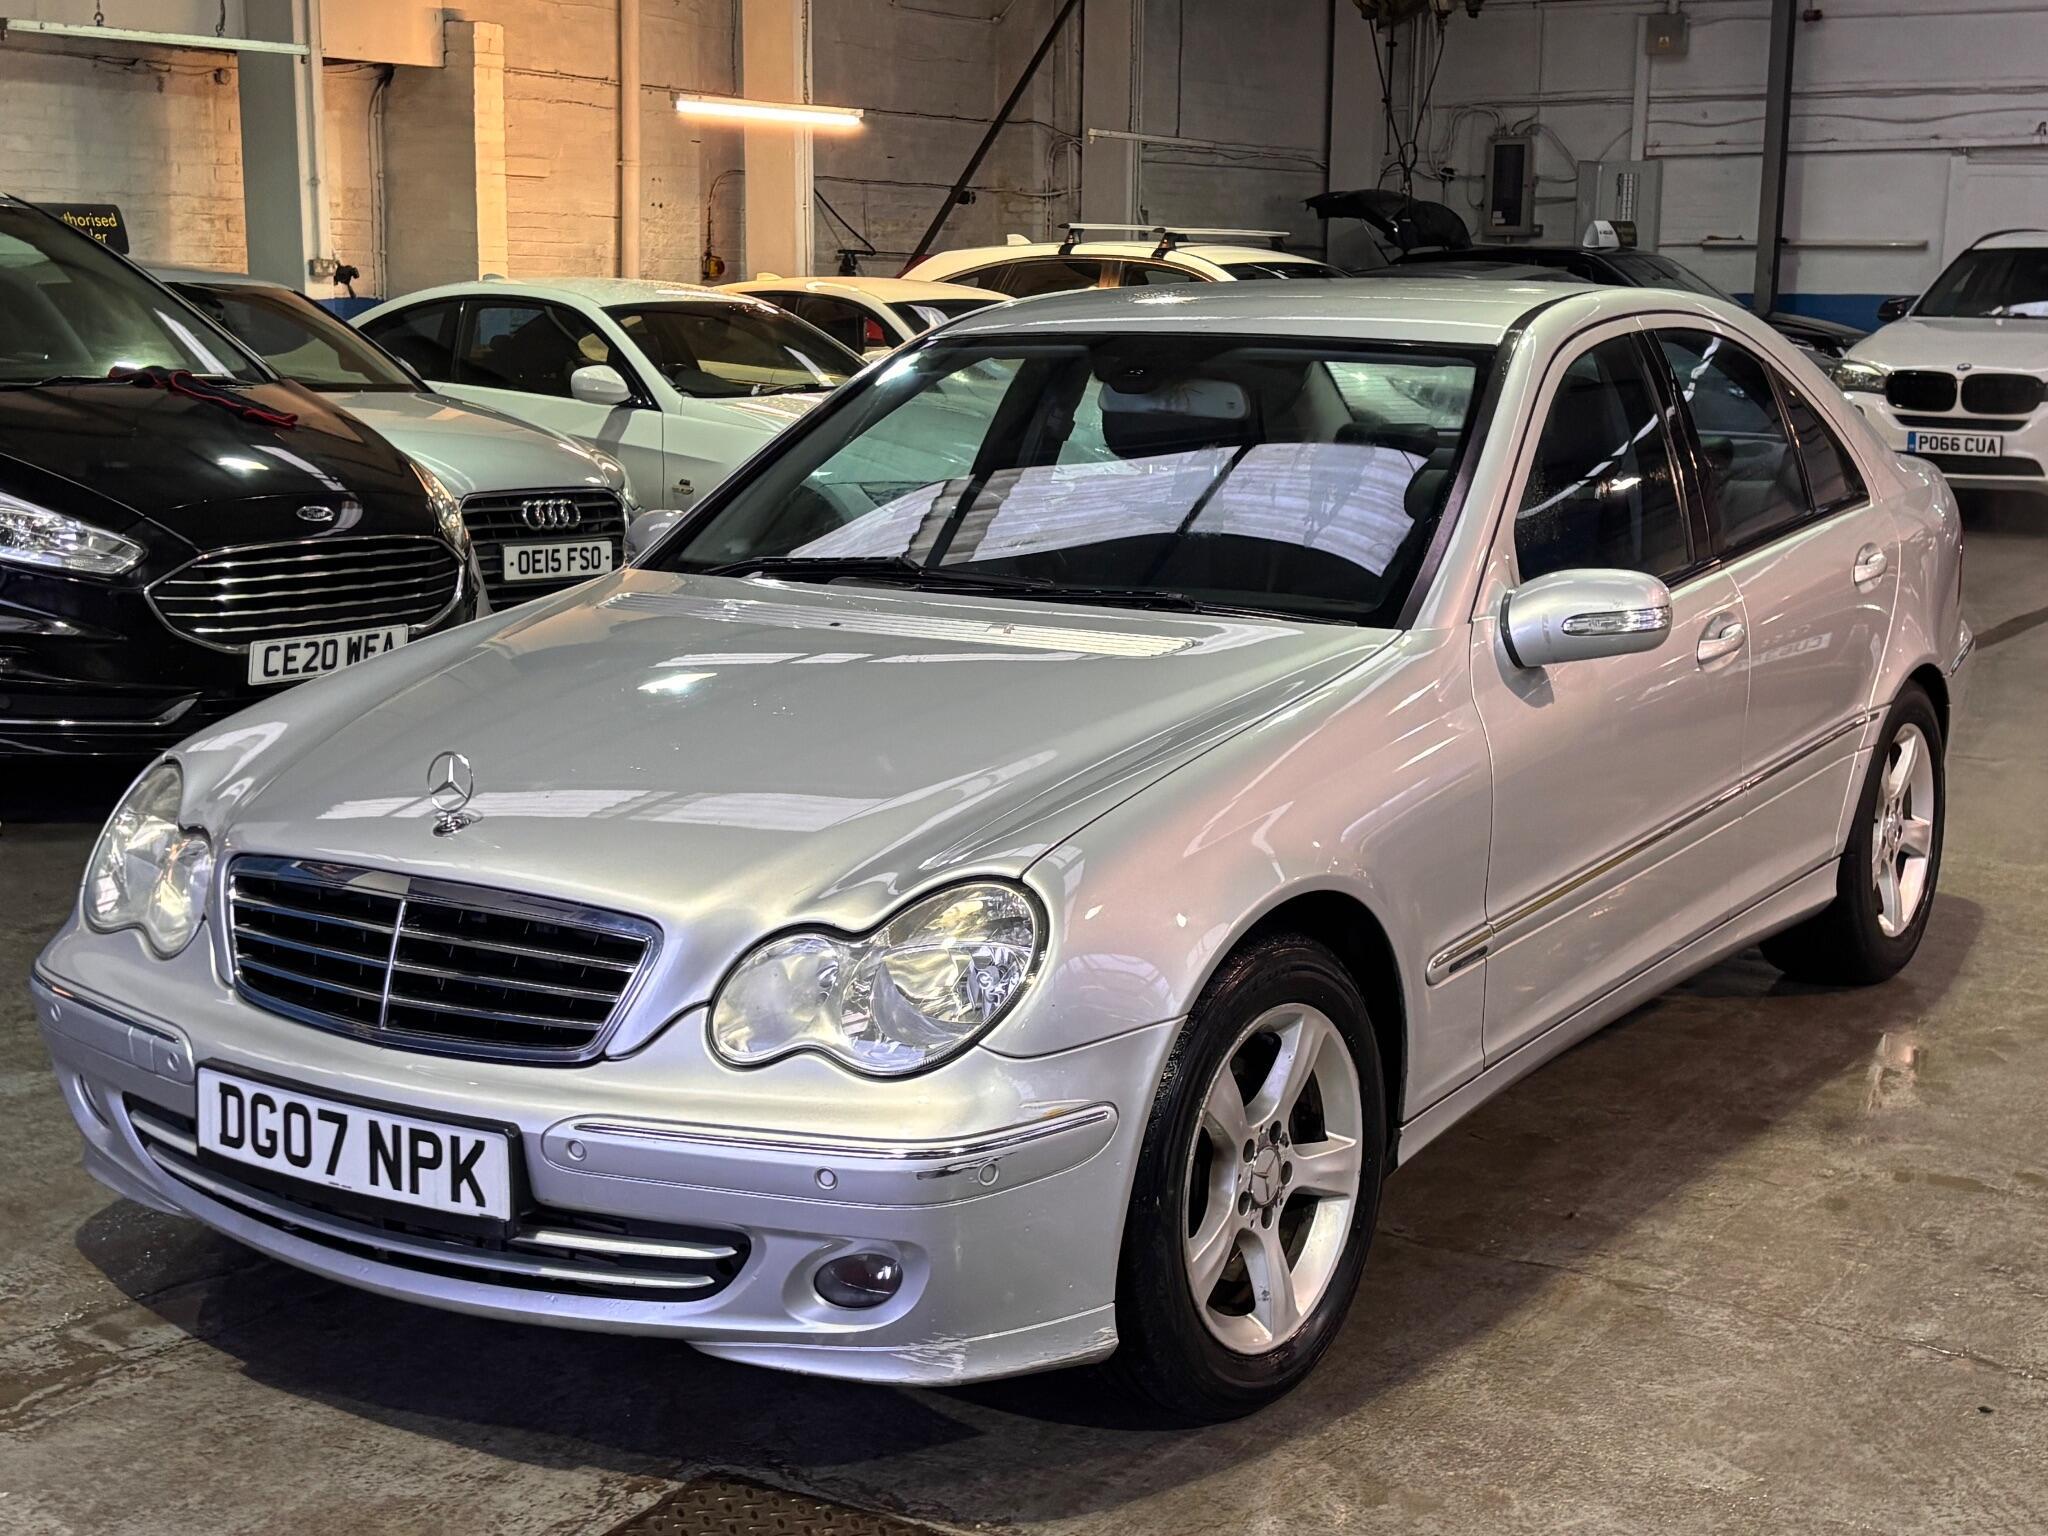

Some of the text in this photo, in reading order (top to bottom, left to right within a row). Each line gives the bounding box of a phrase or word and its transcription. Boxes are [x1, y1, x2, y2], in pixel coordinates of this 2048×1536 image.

[1919, 435, 1997, 454] PO66 CUA
[518, 546, 601, 575] OE15 FSO
[263, 639, 339, 677] CE20
[219, 1082, 486, 1208] DG07 NPK
